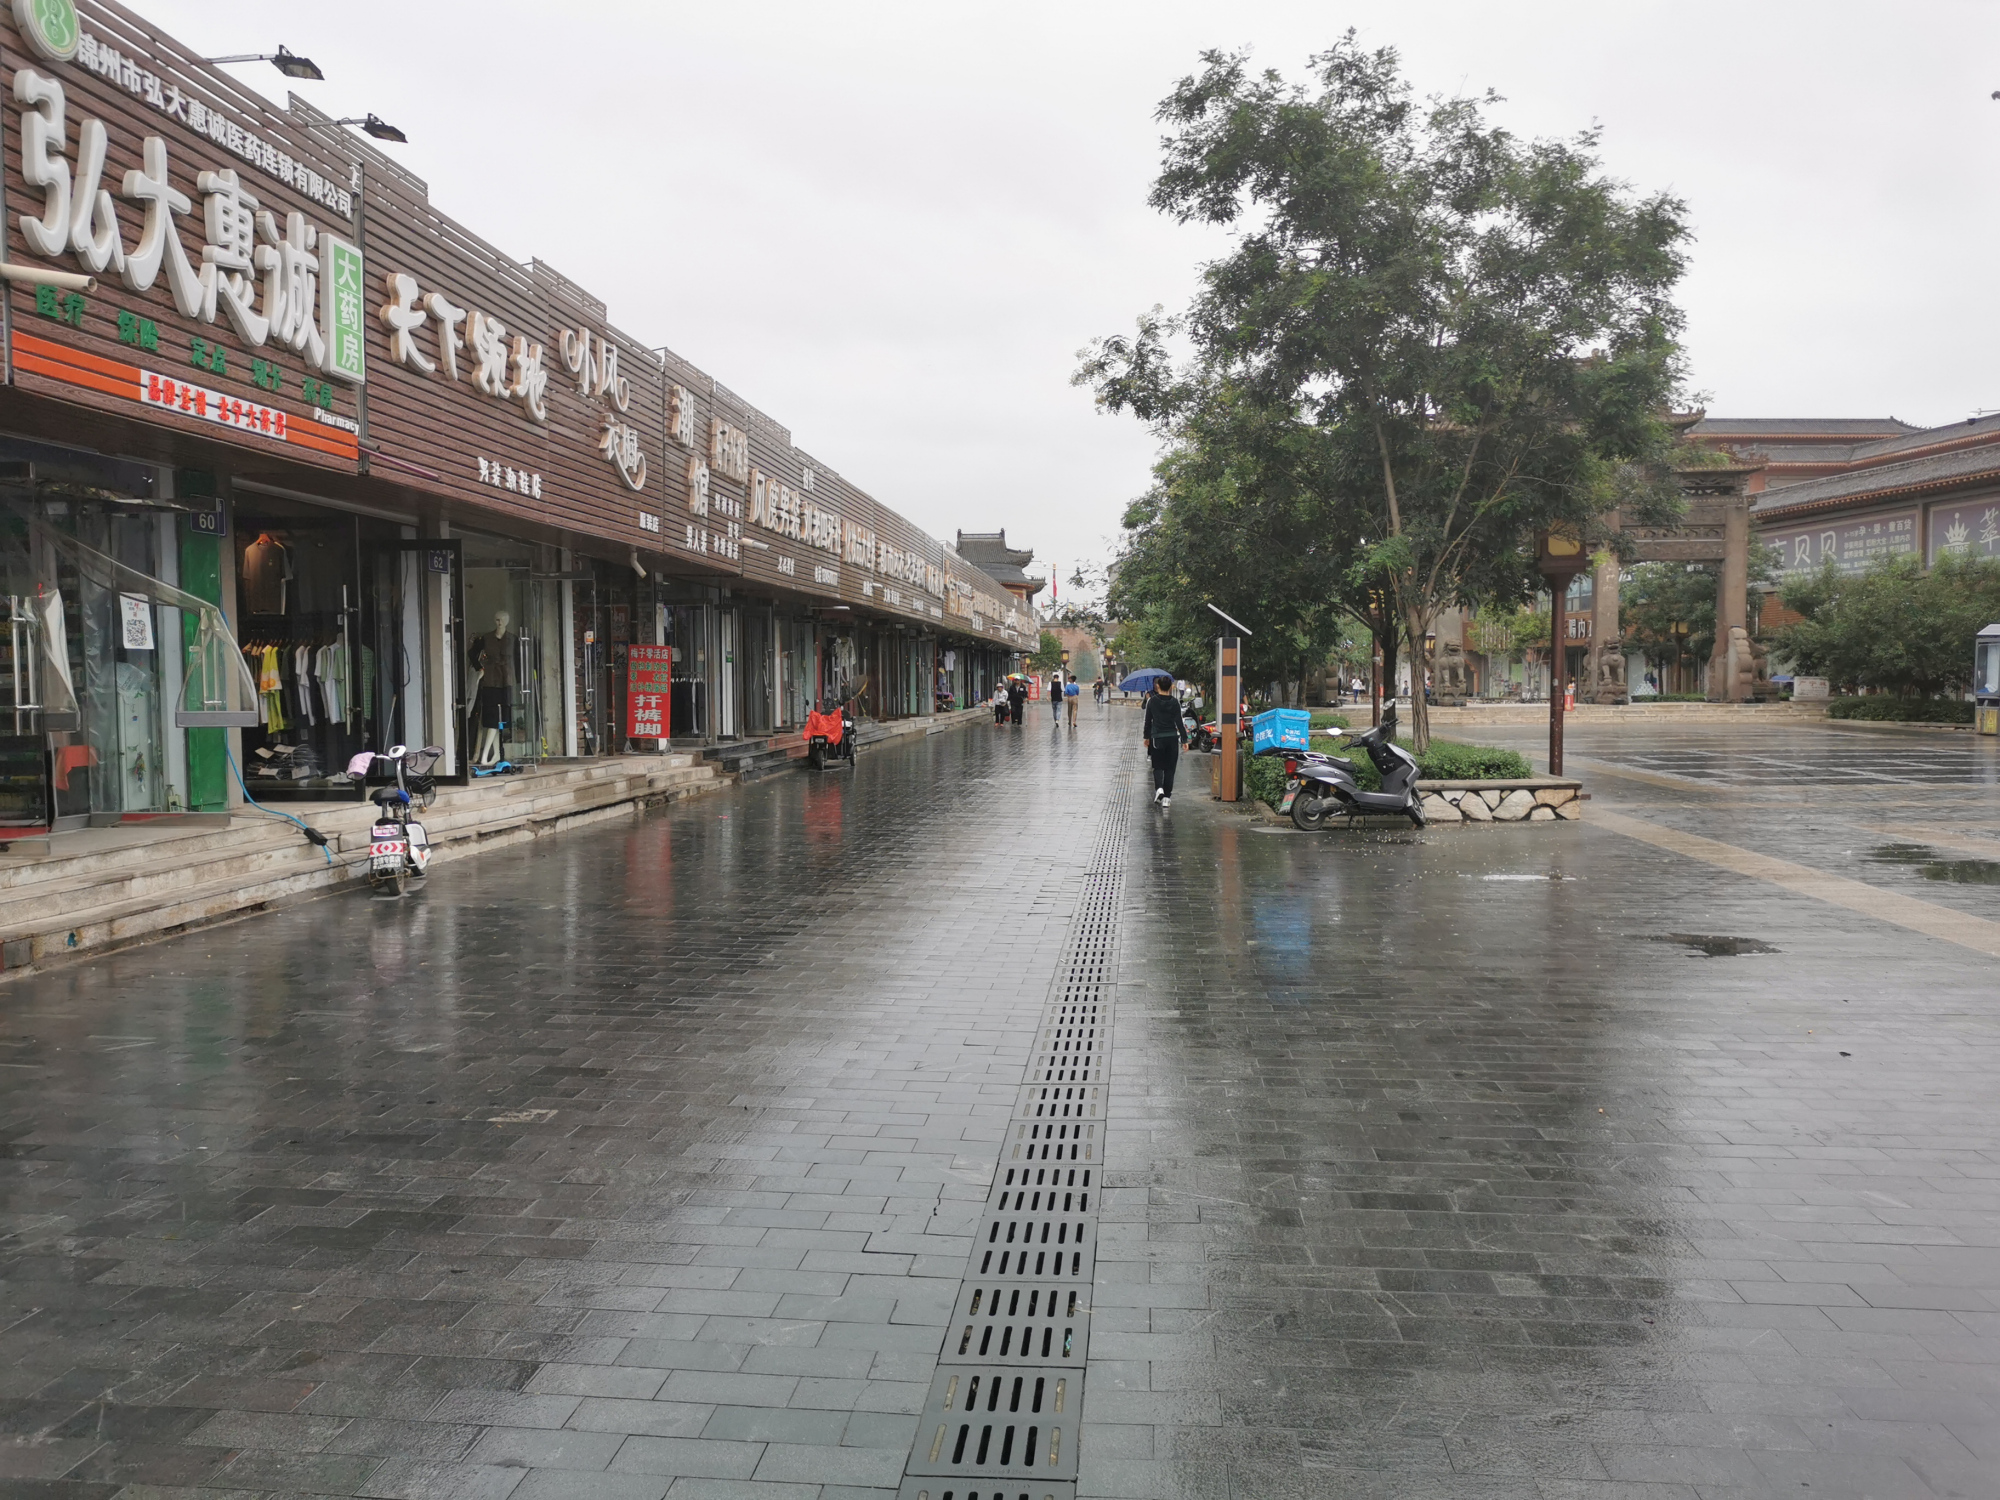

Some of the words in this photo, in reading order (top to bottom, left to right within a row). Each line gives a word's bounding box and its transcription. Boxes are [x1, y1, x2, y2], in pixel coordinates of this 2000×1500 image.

[78, 30, 353, 218] 锦州市弘大惠诚医药连锁有限公司
[13, 69, 325, 368] 弘大惠诚
[36, 284, 85, 326] 医疗
[338, 252, 361, 372] 大药房
[117, 309, 159, 351] 保险
[190, 337, 227, 375] 定点
[148, 375, 207, 416] 品牌连锁
[302, 376, 333, 409] 药房
[218, 396, 285, 436] 北宁大药房
[314, 407, 359, 436] Pharmacy
[477, 456, 542, 499] 男装潮鞋店
[199, 514, 215, 530] 60
[639, 511, 659, 533] 服装店
[686, 524, 708, 554] 男人装
[433, 556, 443, 568] 62
[631, 648, 668, 660] 梅子零活店
